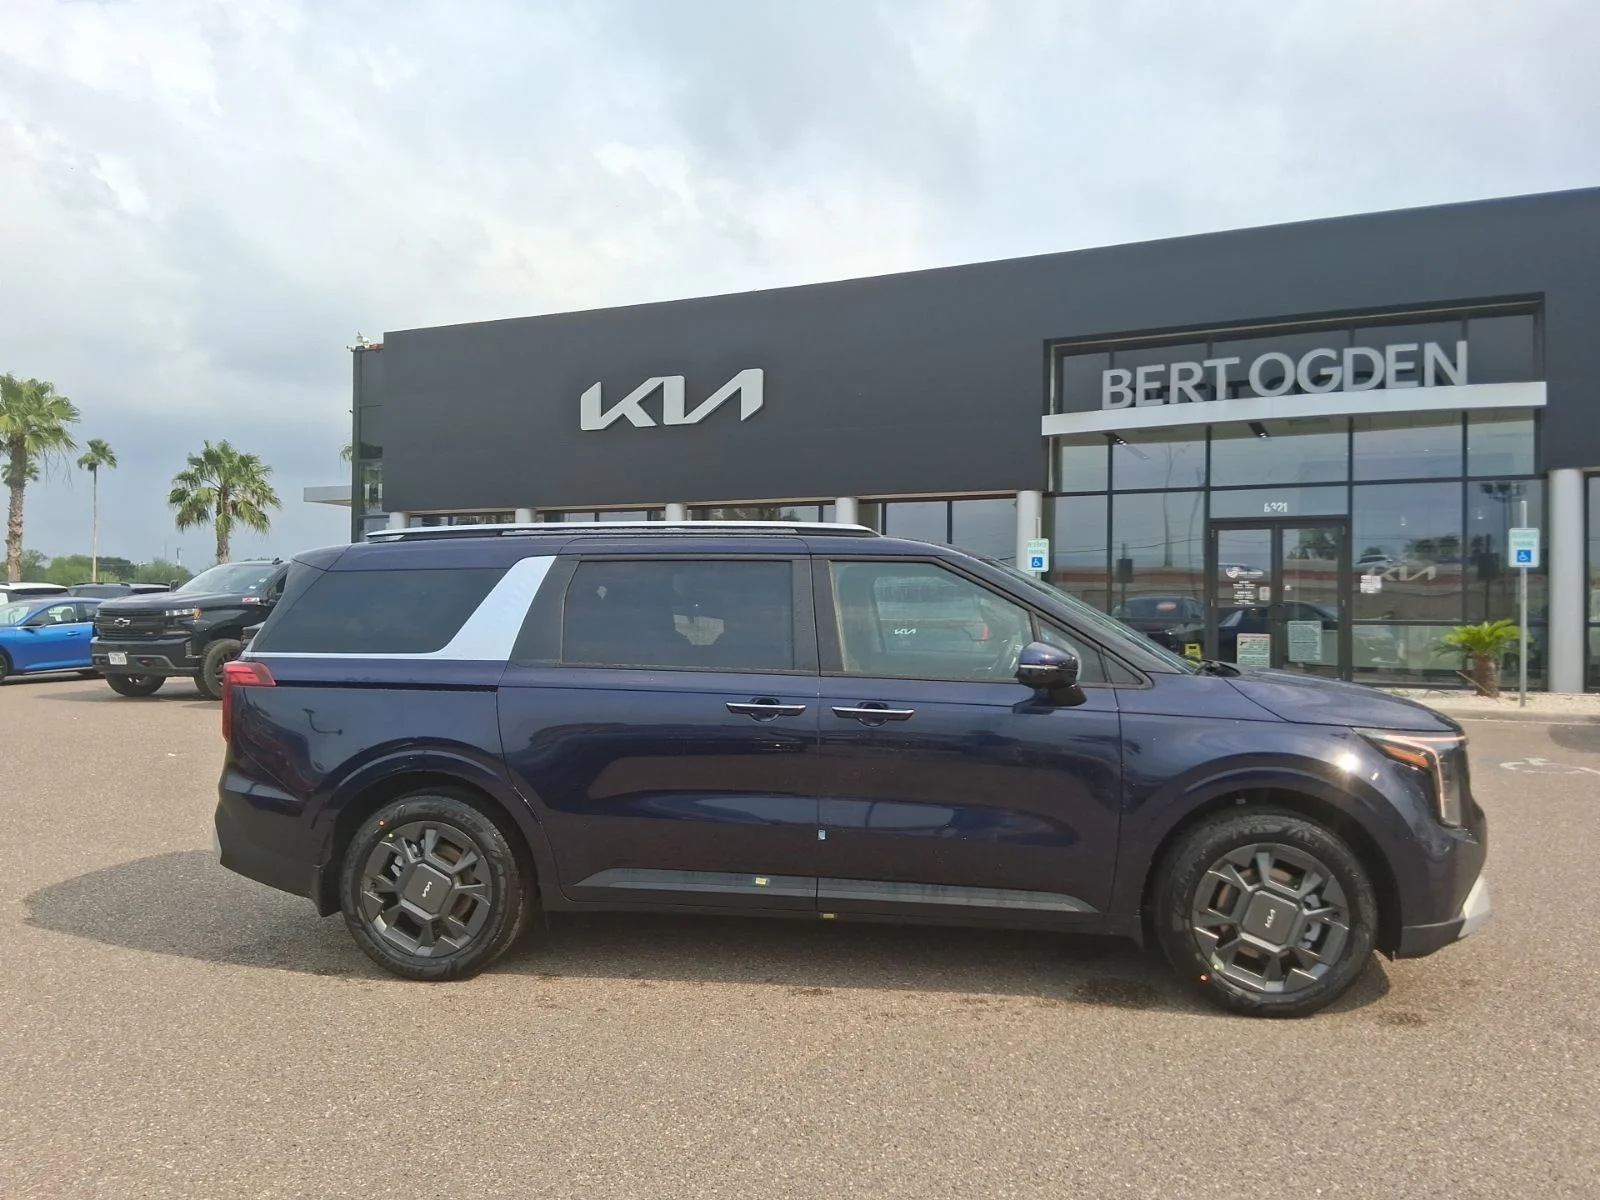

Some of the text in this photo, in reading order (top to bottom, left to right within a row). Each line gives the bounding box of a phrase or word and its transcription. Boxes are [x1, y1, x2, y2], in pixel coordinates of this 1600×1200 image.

[580, 368, 764, 431] KIA
[1102, 340, 1468, 410] BERT OGDEN
